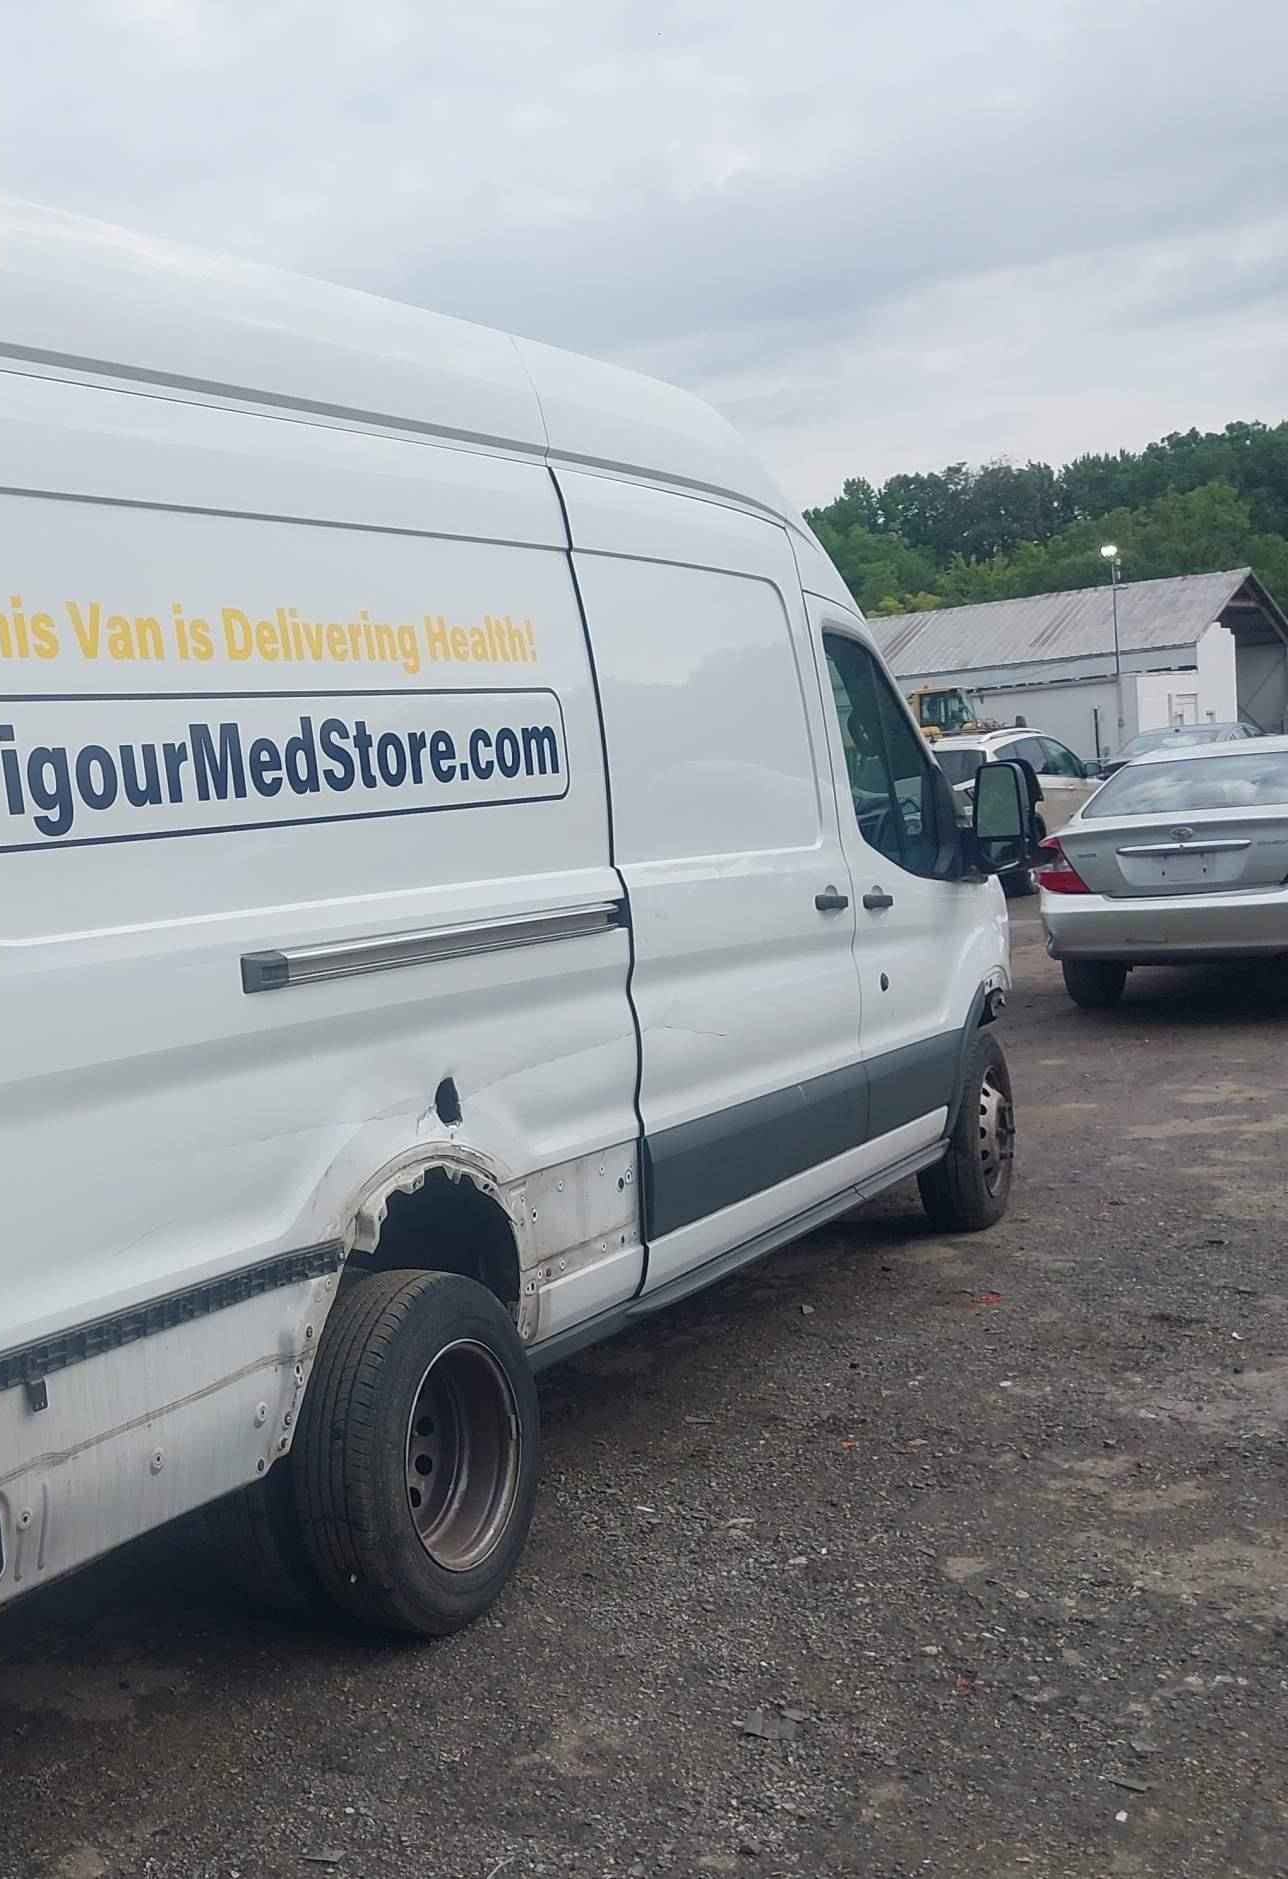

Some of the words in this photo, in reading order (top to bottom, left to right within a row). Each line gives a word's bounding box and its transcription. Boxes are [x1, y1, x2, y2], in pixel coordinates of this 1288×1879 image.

[65, 601, 165, 661] Van
[172, 604, 215, 661] is
[221, 607, 422, 675] Delivering
[424, 615, 539, 663] Health!
